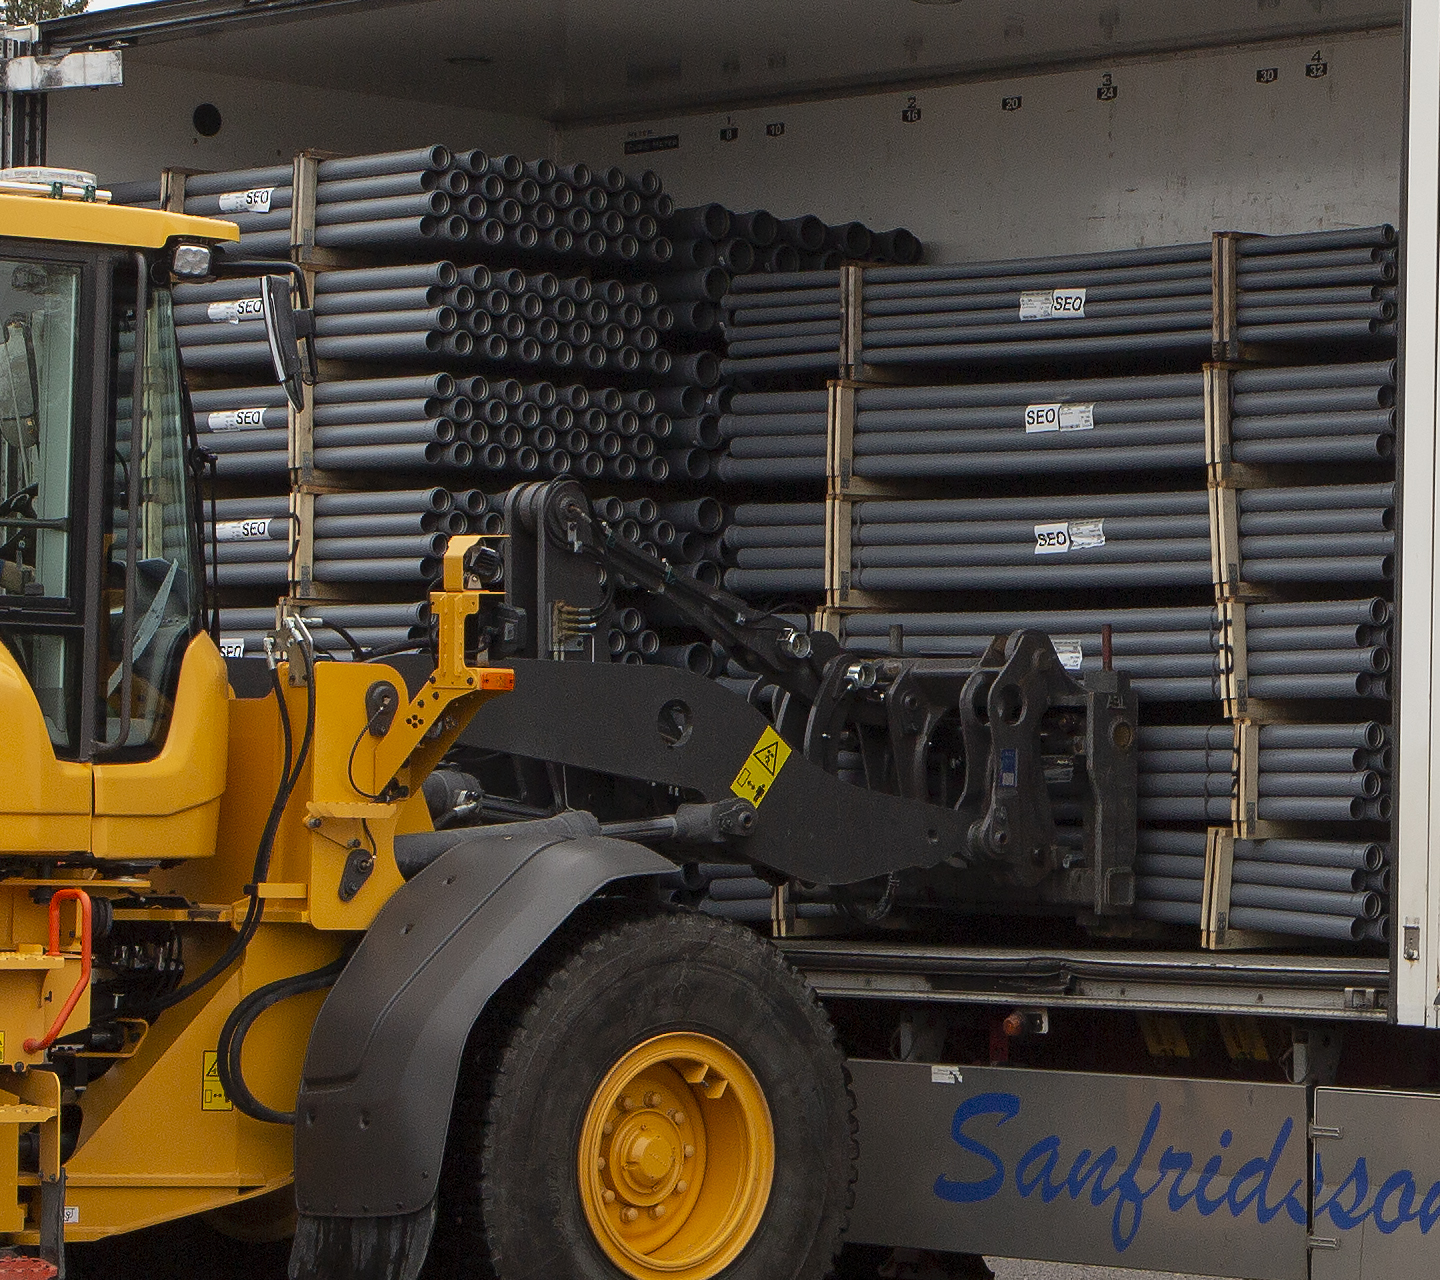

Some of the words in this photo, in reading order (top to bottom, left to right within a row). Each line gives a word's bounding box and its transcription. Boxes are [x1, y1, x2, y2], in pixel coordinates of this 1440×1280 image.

[245, 190, 269, 205] SEO
[237, 300, 263, 315] SEO
[1053, 296, 1083, 312] SEO
[236, 410, 261, 425] SEO
[1026, 408, 1056, 426] SEO
[242, 521, 266, 537] SEO
[1037, 531, 1067, 548] SEO
